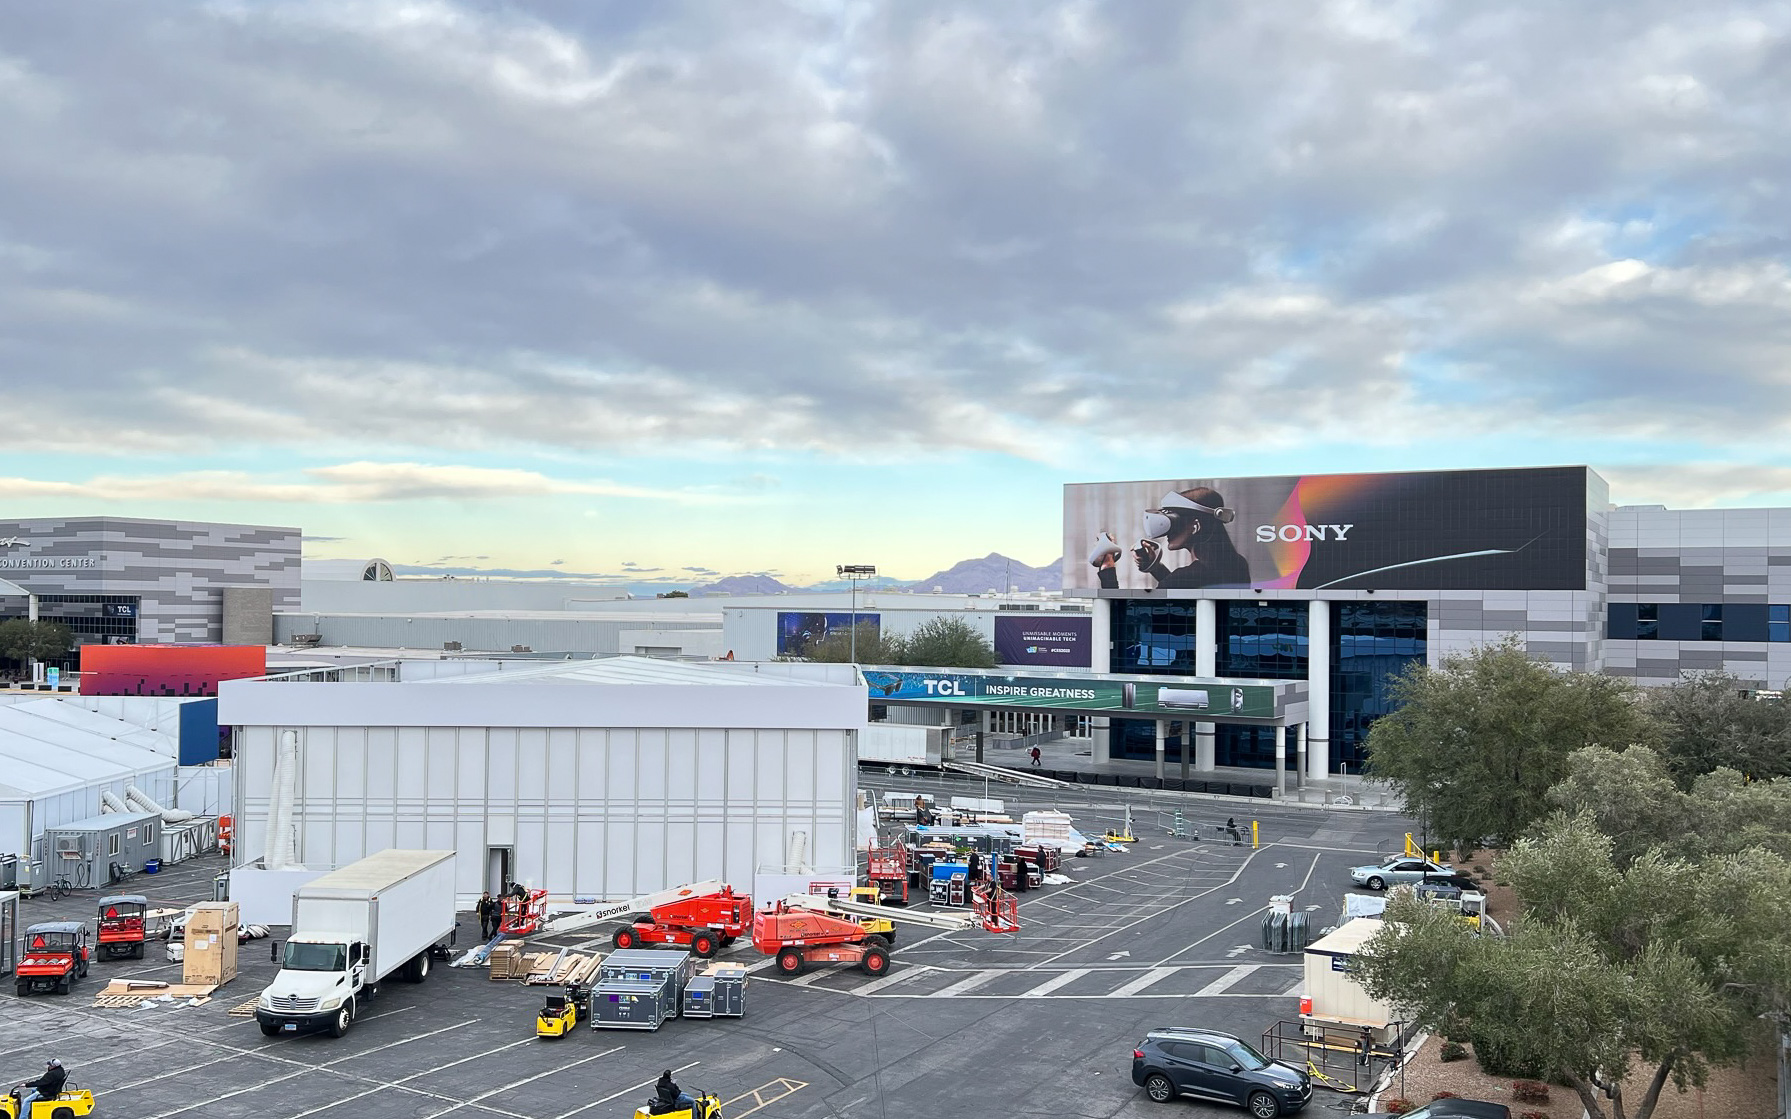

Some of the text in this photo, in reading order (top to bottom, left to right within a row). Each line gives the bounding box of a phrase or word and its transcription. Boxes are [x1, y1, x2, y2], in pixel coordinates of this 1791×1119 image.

[1256, 524, 1354, 542] SONY
[60, 558, 95, 568] CENTER
[924, 680, 966, 696] TCL
[985, 685, 1096, 699] INSPIRE GREATNESS
[602, 903, 631, 917] snorkel
